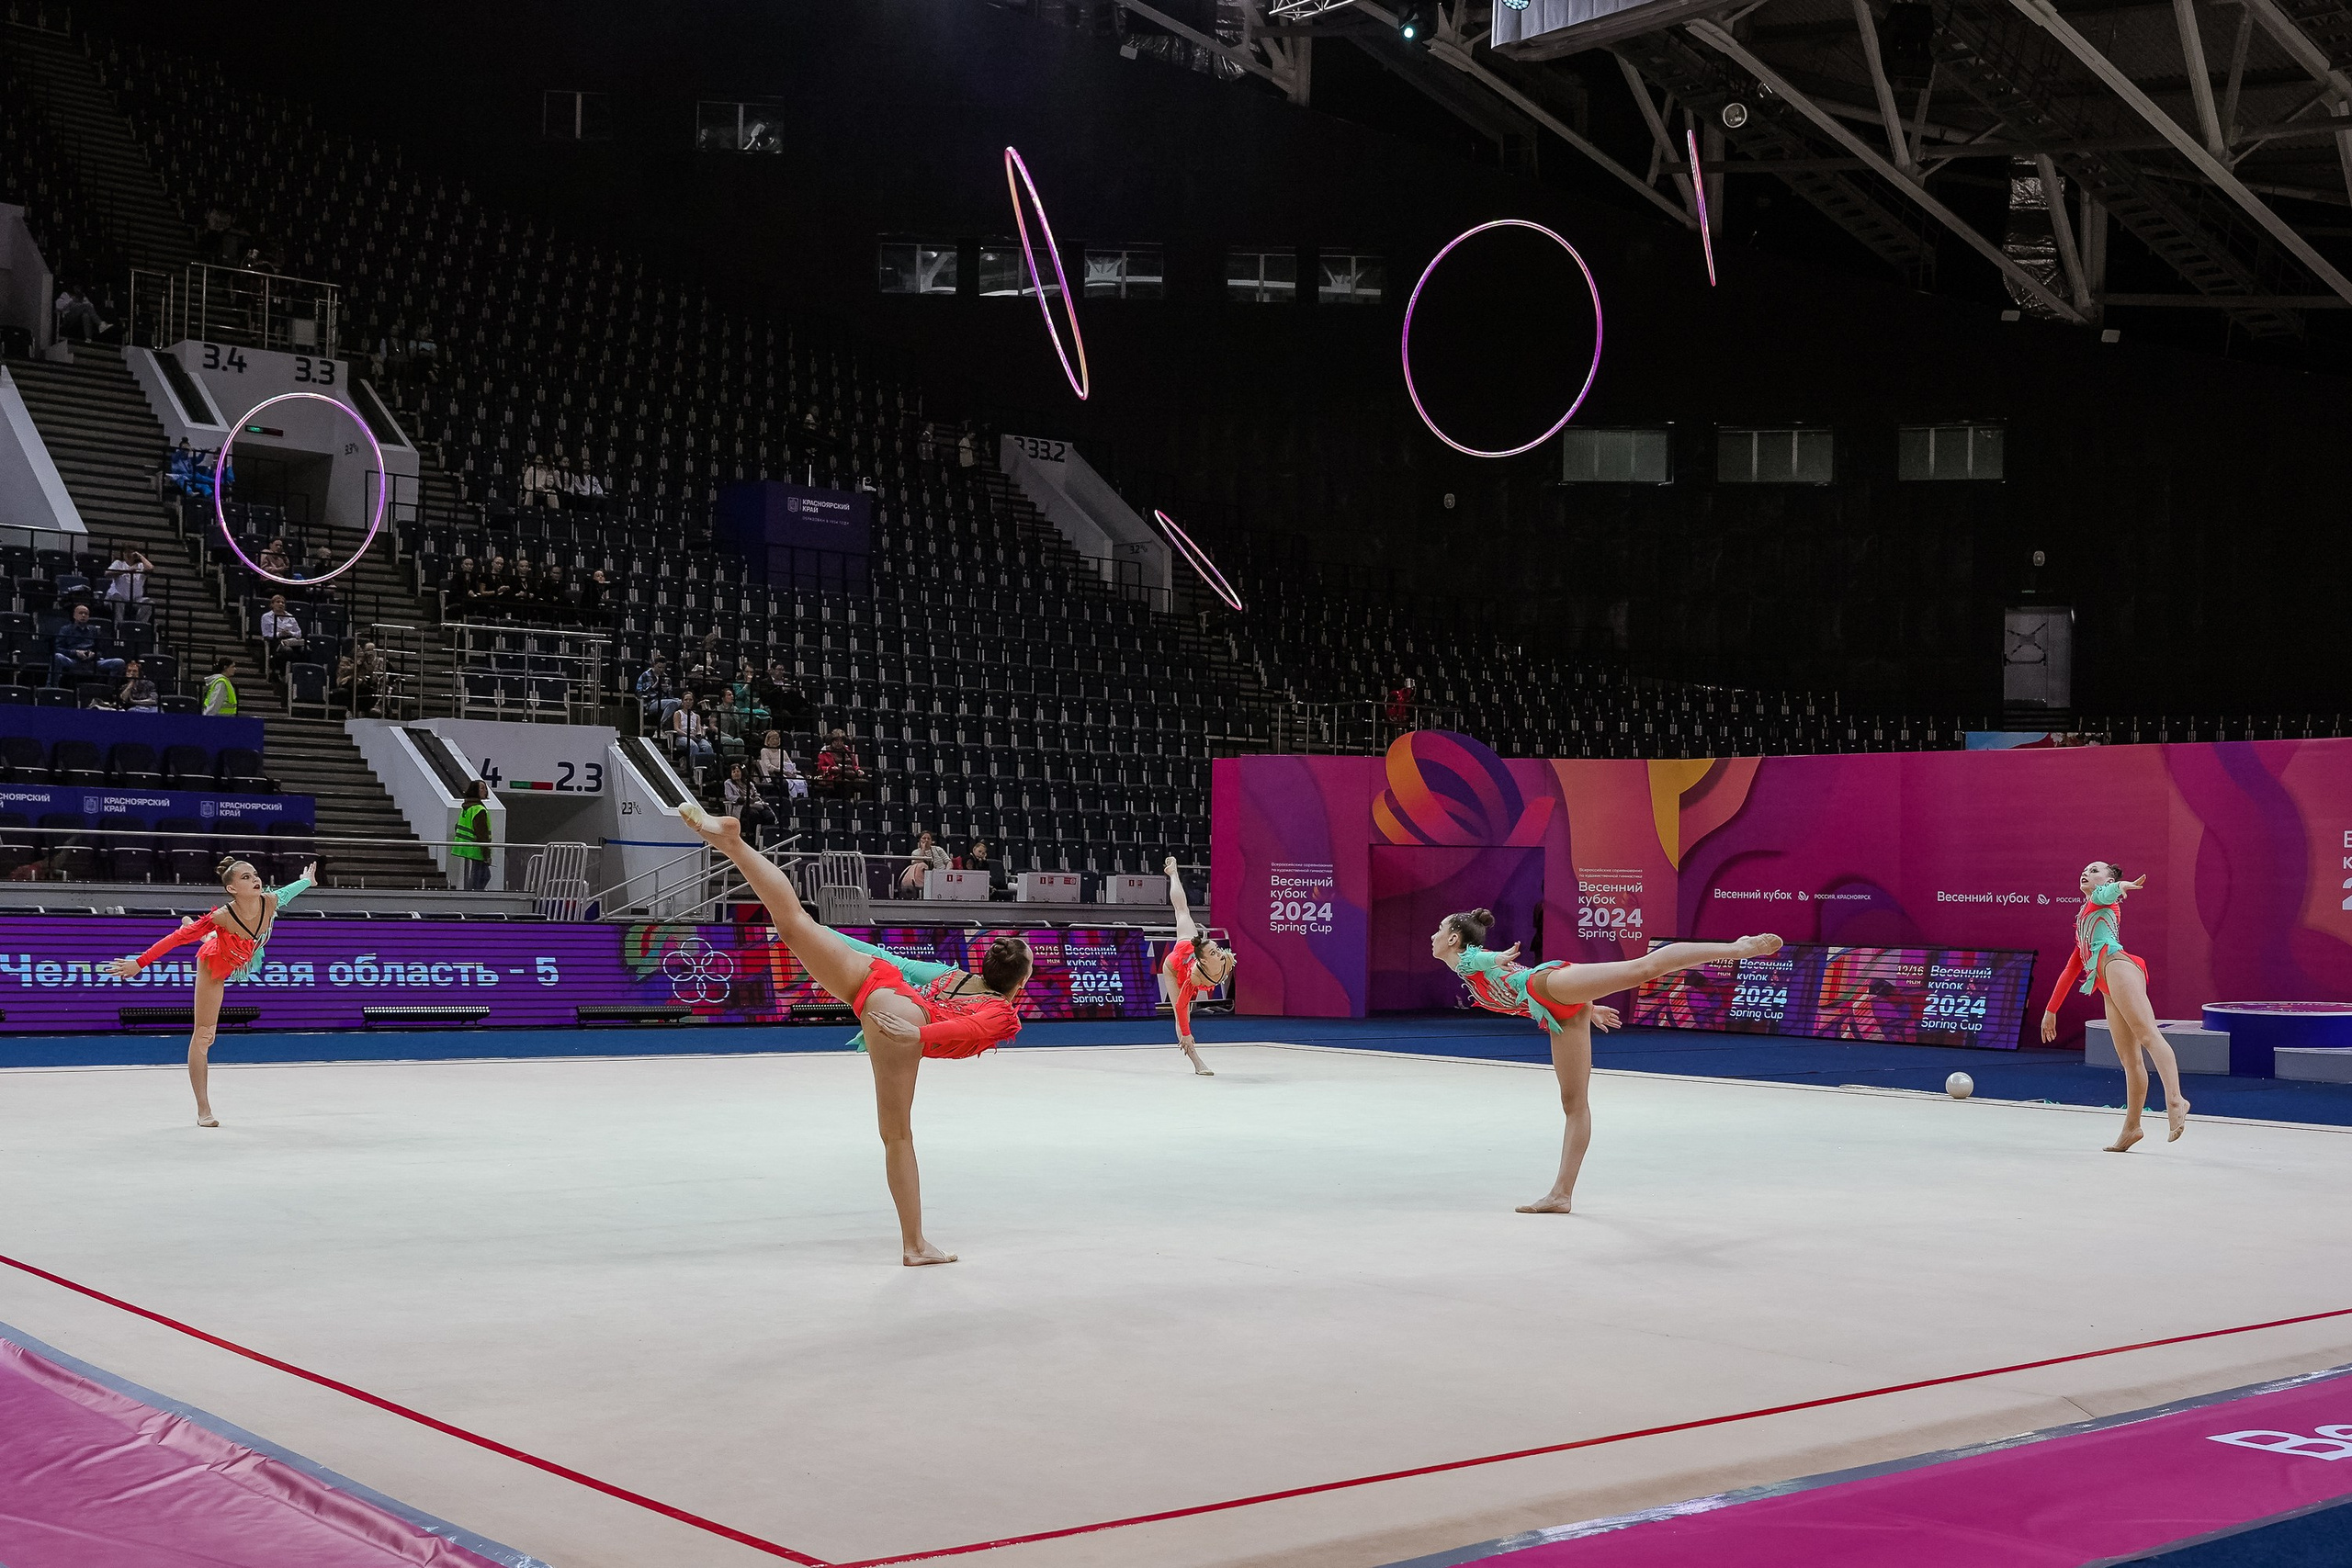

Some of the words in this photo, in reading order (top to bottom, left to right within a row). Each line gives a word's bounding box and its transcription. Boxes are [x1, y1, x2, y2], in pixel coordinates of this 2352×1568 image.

[202, 344, 247, 373] 3.4
[294, 356, 335, 385] 3.3
[802, 499, 850, 511] КРАСНОЯРСКИЙ
[802, 505, 819, 513] КРАЙ
[556, 761, 603, 793] 2.3
[104, 796, 170, 807] КРАСНОЯРСКИЙ
[220, 801, 282, 811] КРАСНОЯРСКИЙ
[104, 805, 126, 813] КРАЙ
[220, 808, 241, 817] КРАЙ
[1271, 875, 1333, 886] Весенний
[1578, 881, 1643, 892] Весенний
[1270, 887, 1307, 900] кубок
[1578, 893, 1616, 907] кубок
[1713, 888, 1761, 899] Весенний
[1763, 889, 1792, 902] кубок
[1937, 890, 1993, 903] Весенний
[1996, 891, 2030, 906] кубок
[1270, 901, 1333, 921] 2024
[1577, 908, 1643, 928] 2024
[1270, 921, 1306, 935] Spring
[1309, 922, 1332, 934] Cup
[1577, 928, 1616, 942] Spring
[1619, 929, 1643, 941] Cup
[1035, 945, 1059, 956] 12/16
[1064, 944, 1117, 955] Весенний
[329, 953, 499, 987] область
[536, 957, 560, 987] 5
[1739, 958, 1793, 970] Весенний
[1896, 964, 1924, 976] 12/16
[1930, 965, 1992, 978] Весенний
[1069, 971, 1123, 991] 2024
[1072, 993, 1103, 1006] Spring
[1105, 993, 1125, 1005] Cup
[1731, 985, 1788, 1008] 2024
[1922, 994, 1986, 1019] 2024
[1729, 1007, 1762, 1021] Spring
[1764, 1009, 1784, 1021] Cup
[1921, 1017, 1957, 1032] Spring
[1960, 1020, 1983, 1033] Cup
